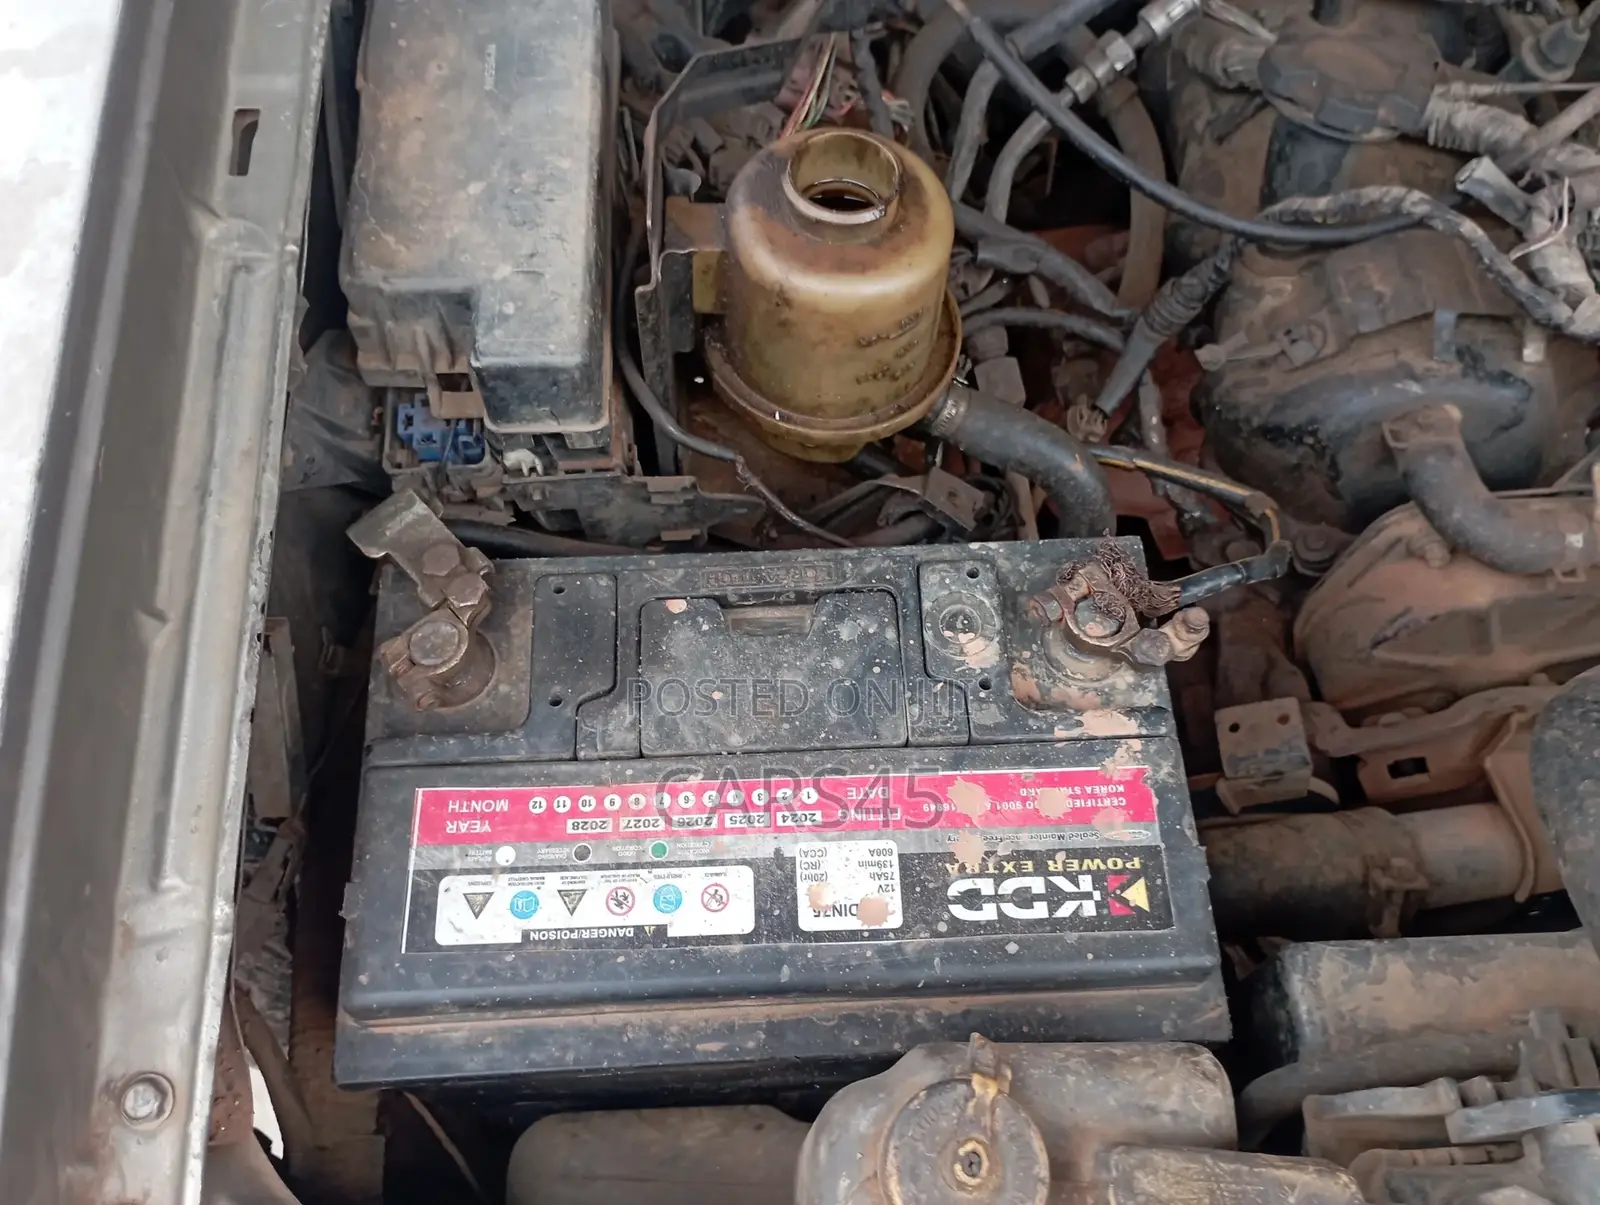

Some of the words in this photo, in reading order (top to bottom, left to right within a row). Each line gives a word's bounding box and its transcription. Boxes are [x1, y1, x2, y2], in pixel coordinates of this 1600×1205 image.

[847, 786, 888, 799] DATE
[1084, 784, 1125, 795] KOREA
[659, 796, 665, 805] 7
[684, 795, 689, 804] 6
[708, 794, 714, 803] 5
[757, 793, 763, 802] 3
[782, 792, 788, 801] 2
[807, 791, 811, 800] 1
[448, 799, 509, 813] MONTH
[532, 800, 543, 810] 12
[557, 799, 567, 809] 11
[581, 799, 593, 808] 10
[609, 798, 615, 807] 9
[634, 797, 640, 806] 8
[995, 800, 1023, 811] 9001
[1065, 797, 1126, 808] CERTIFIED
[729, 814, 765, 825] 2025
[781, 813, 816, 823] 2024
[838, 808, 900, 821] FITTING
[446, 820, 491, 833] YEAR
[571, 820, 608, 831] 2028
[624, 818, 661, 830] 2027
[676, 816, 714, 828] 2026
[982, 835, 1003, 844] Free
[1067, 831, 1100, 842] Sealed
[799, 847, 827, 858] (CCA)
[799, 859, 821, 870] (RC)
[858, 860, 894, 870] 139min
[945, 859, 1033, 875] EXTRA
[1046, 857, 1141, 873] POWER
[800, 871, 828, 883] (20hr)
[869, 871, 895, 881] 75Ah
[878, 884, 895, 893] 12V
[946, 875, 1101, 921] KDD
[529, 927, 634, 941] DANGER/POISON
